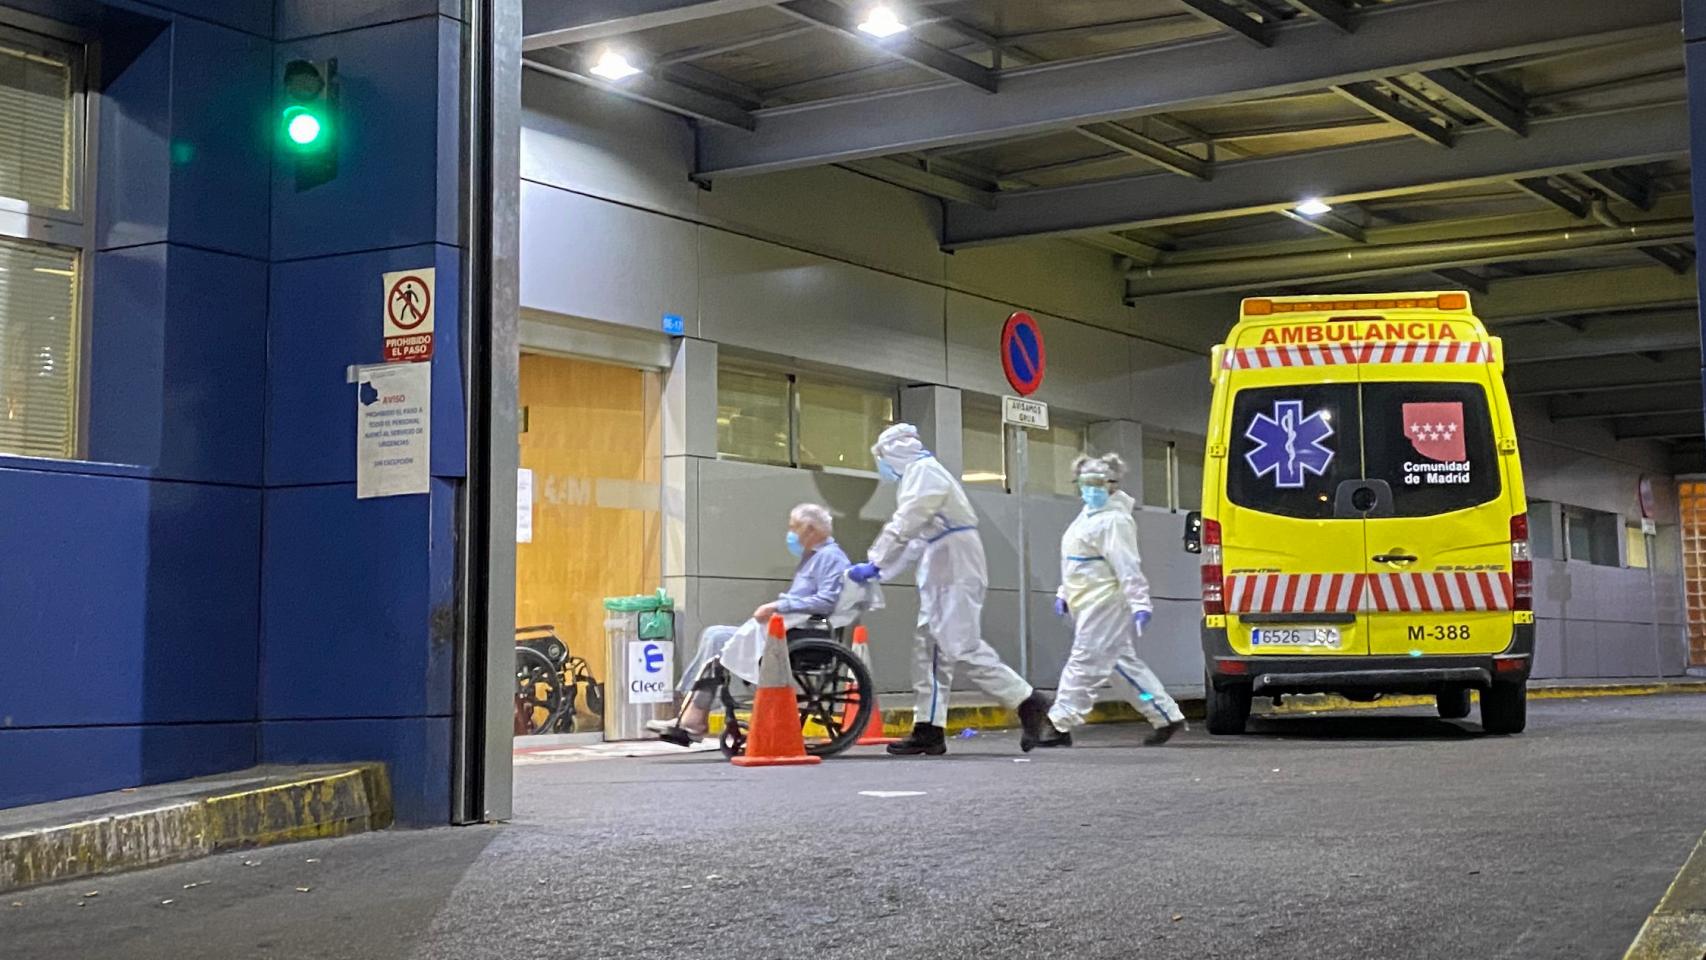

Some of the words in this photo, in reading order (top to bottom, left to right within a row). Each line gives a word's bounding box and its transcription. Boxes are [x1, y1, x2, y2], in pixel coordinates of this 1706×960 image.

[1261, 323, 1457, 345] AMBULANCIA
[386, 335, 431, 348] PROHIBIDO
[392, 347, 402, 356] EL
[403, 345, 427, 355] PASO
[383, 395, 406, 405] AVISO
[1403, 461, 1470, 472] Comunidad
[1404, 473, 1420, 484] de
[1427, 472, 1470, 484] Madrid
[1262, 629, 1300, 643] 6526
[1408, 625, 1471, 640] M-388
[631, 680, 665, 693] Clece
